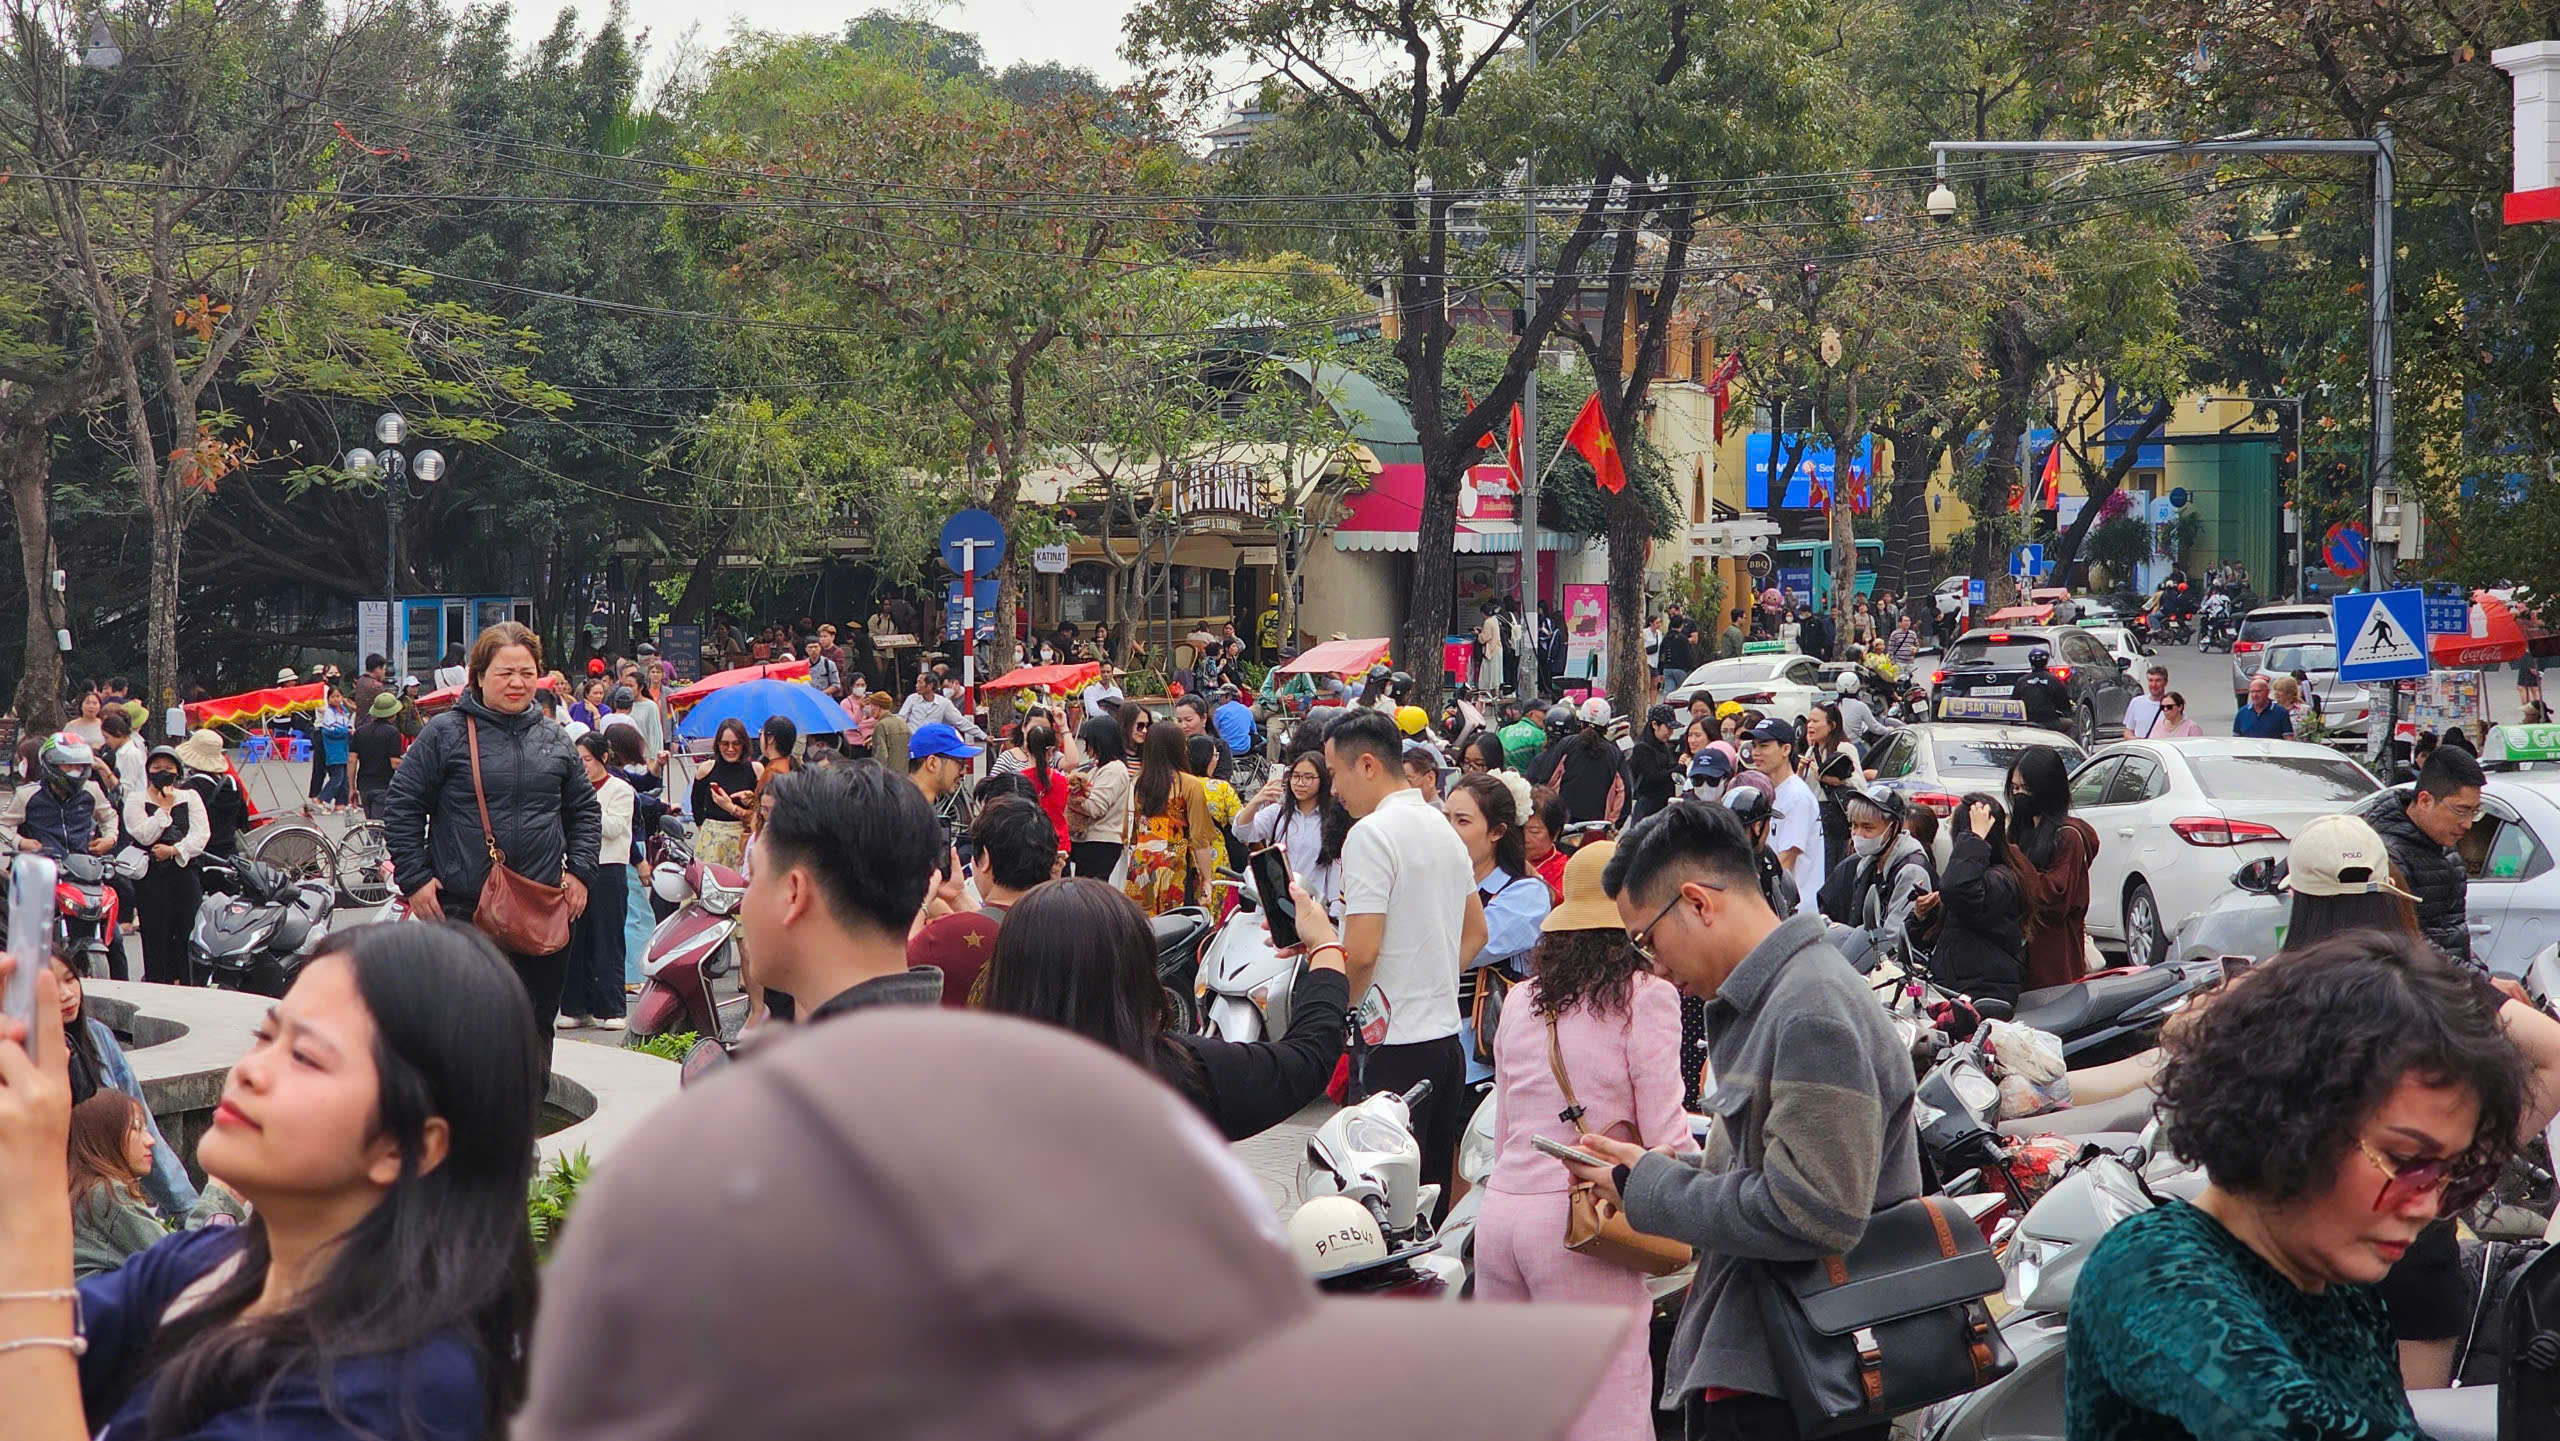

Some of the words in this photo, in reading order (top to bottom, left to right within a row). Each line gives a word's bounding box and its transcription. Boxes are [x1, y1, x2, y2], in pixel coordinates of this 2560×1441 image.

[1036, 551, 1066, 562] KATINAT
[1749, 561, 1768, 569] BBQ
[1967, 702, 1985, 712] SAO
[2342, 851, 2362, 860] POLO
